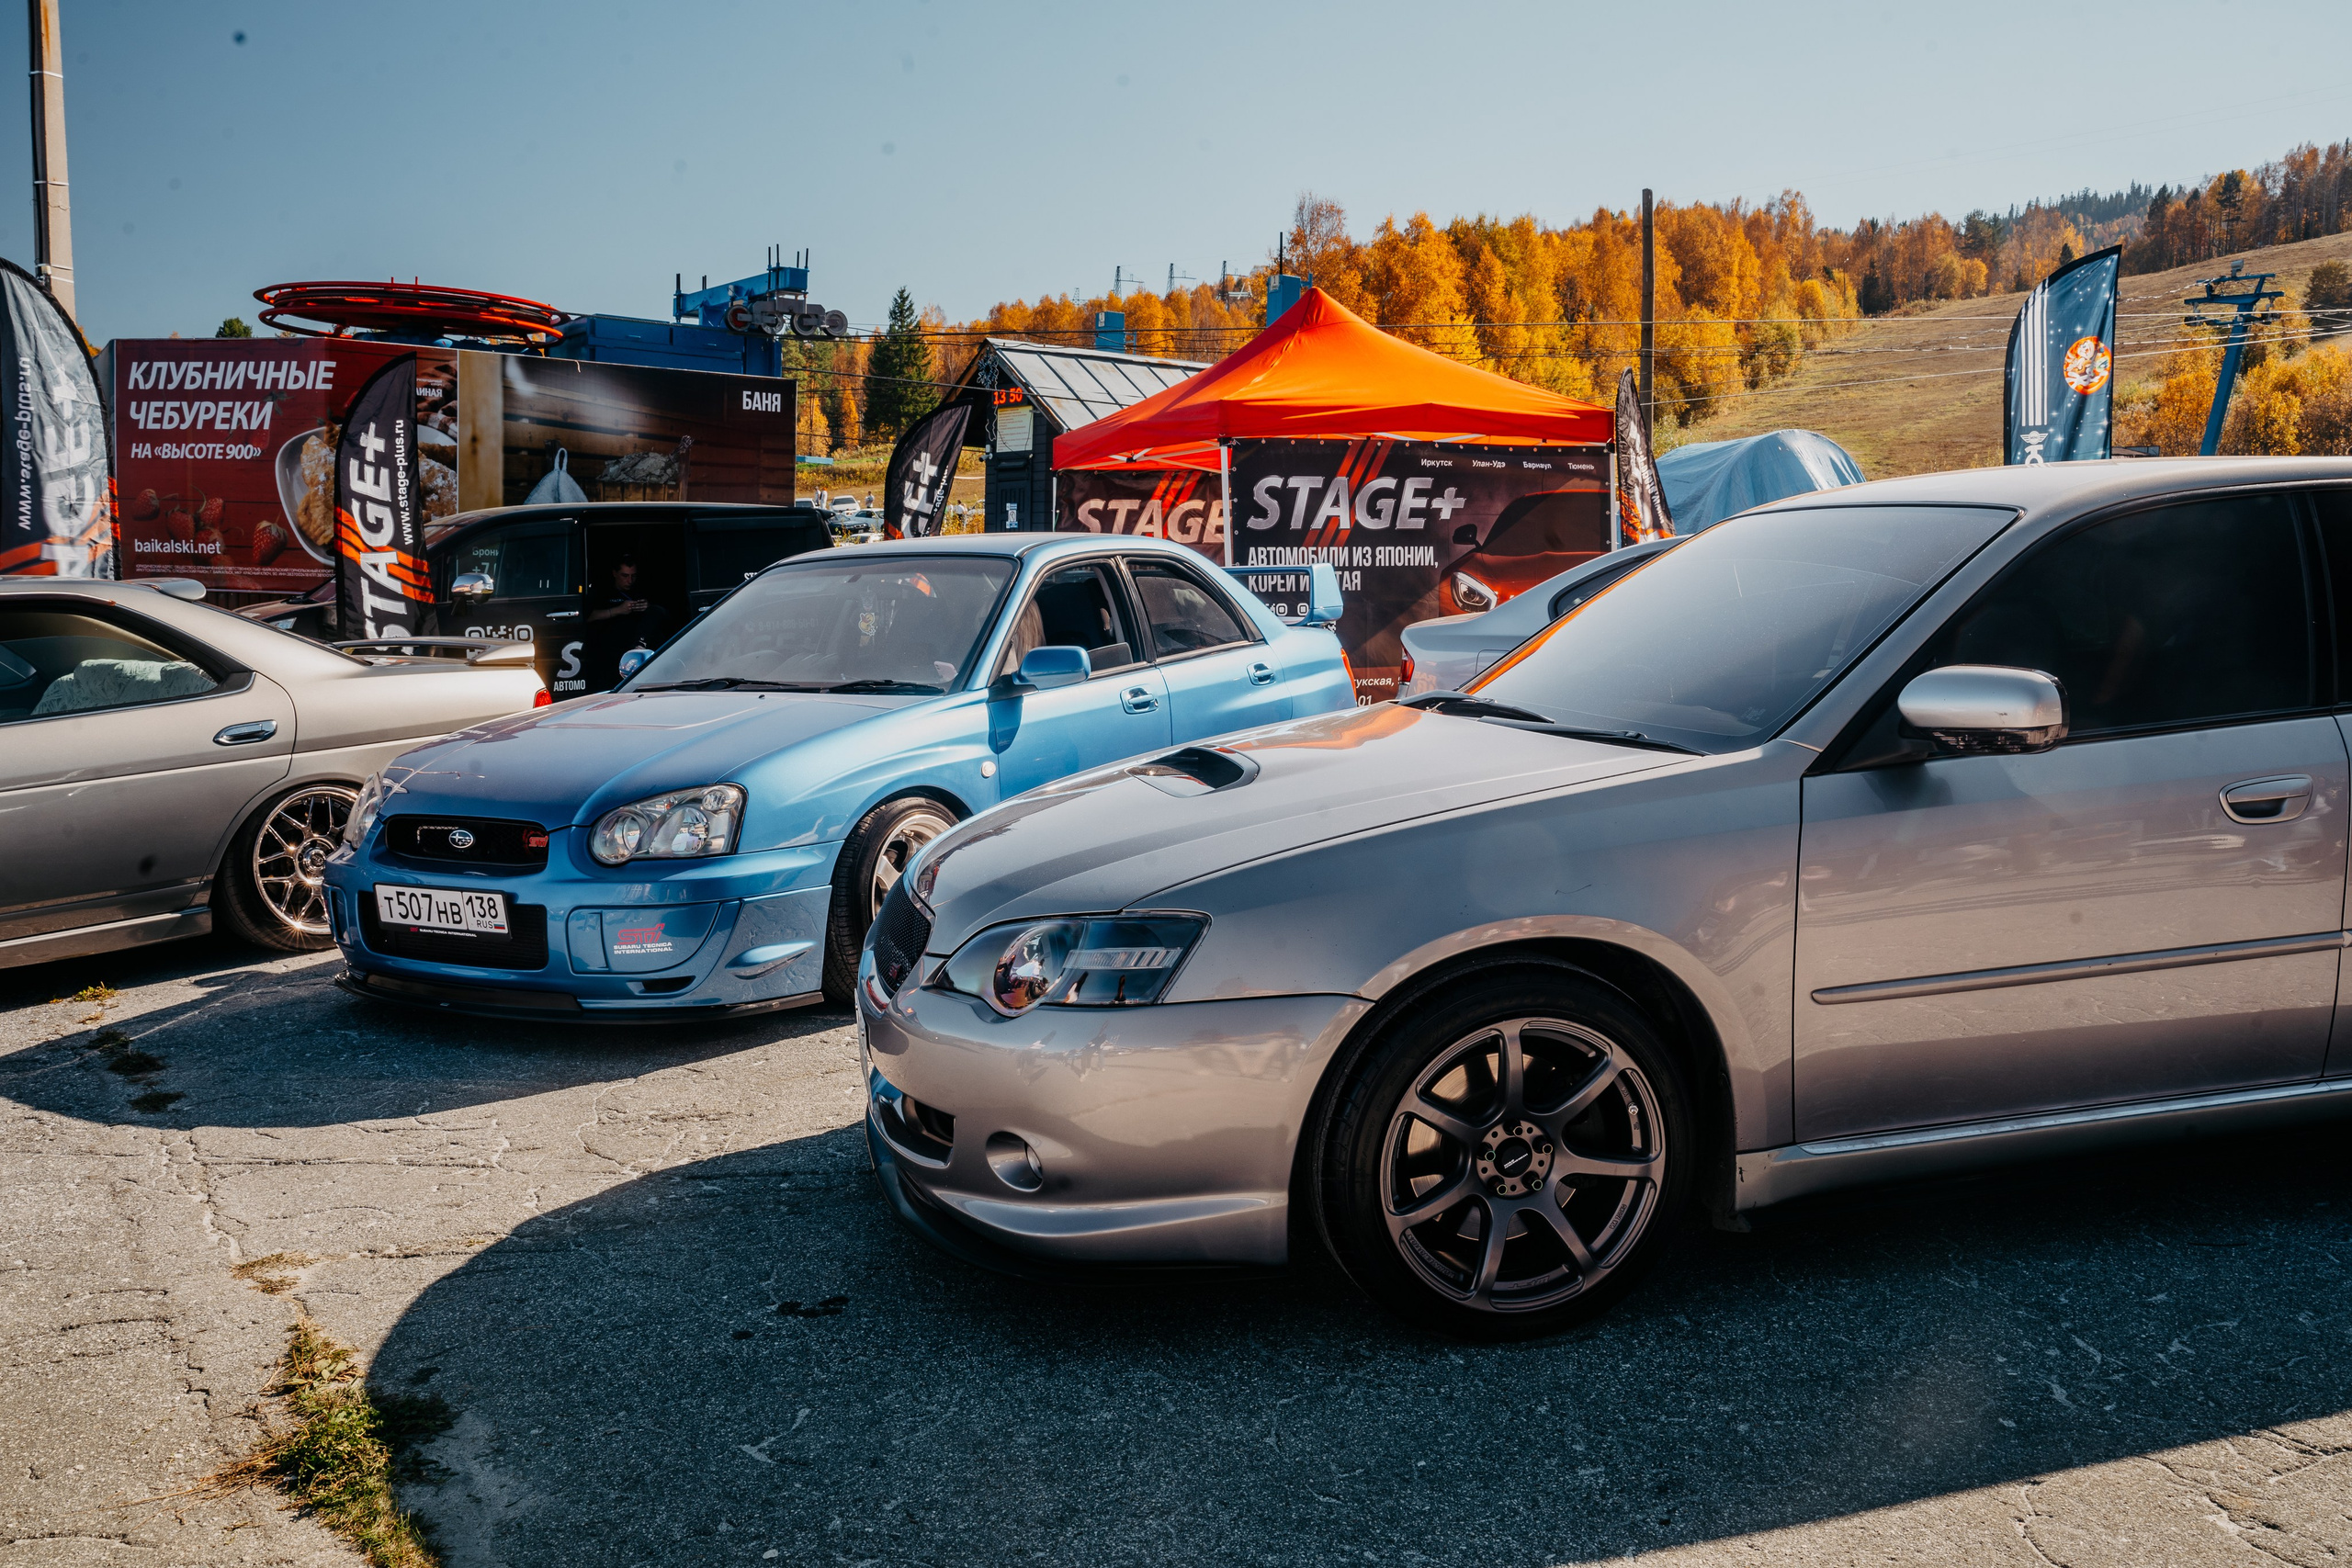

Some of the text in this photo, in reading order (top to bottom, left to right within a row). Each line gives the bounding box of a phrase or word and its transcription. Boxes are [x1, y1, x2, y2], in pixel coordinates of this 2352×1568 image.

[128, 360, 337, 390] КЛУБНИЧНЫЕ
[741, 390, 782, 412] БАНЯ
[128, 400, 275, 431] ЧЕБУРЕКИ
[130, 442, 262, 460] НА «ВЫСОТЕ 900»
[1420, 458, 1595, 470] Иркутск Улан-Удэ Барнаул Тюмень
[393, 419, 414, 546] www.stage-plus.ru
[1246, 474, 1467, 531] STAGE+
[134, 538, 221, 555] baikalski.net
[1248, 546, 1439, 569] АВТОМОБИЛИ ИЗ ЯПОНИИ,
[465, 895, 499, 919] 138
[476, 919, 493, 929] RUS
[614, 946, 673, 954] INTERNATIONAL
